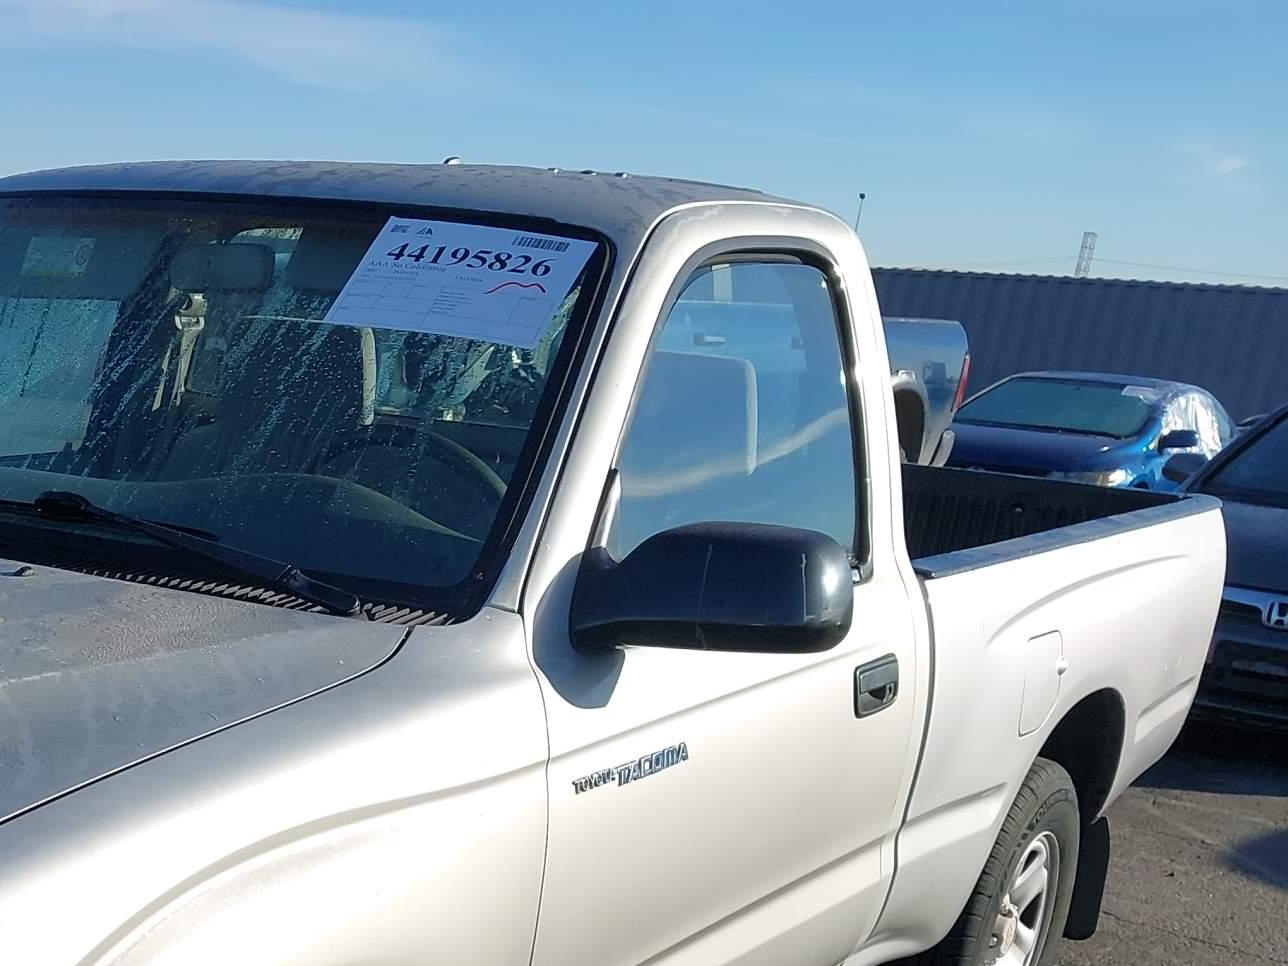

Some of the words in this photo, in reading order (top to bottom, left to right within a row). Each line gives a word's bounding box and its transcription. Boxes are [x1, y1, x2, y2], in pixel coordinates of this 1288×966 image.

[386, 242, 558, 277] 44195826
[404, 262, 447, 273] California
[614, 742, 689, 787] TACOMA
